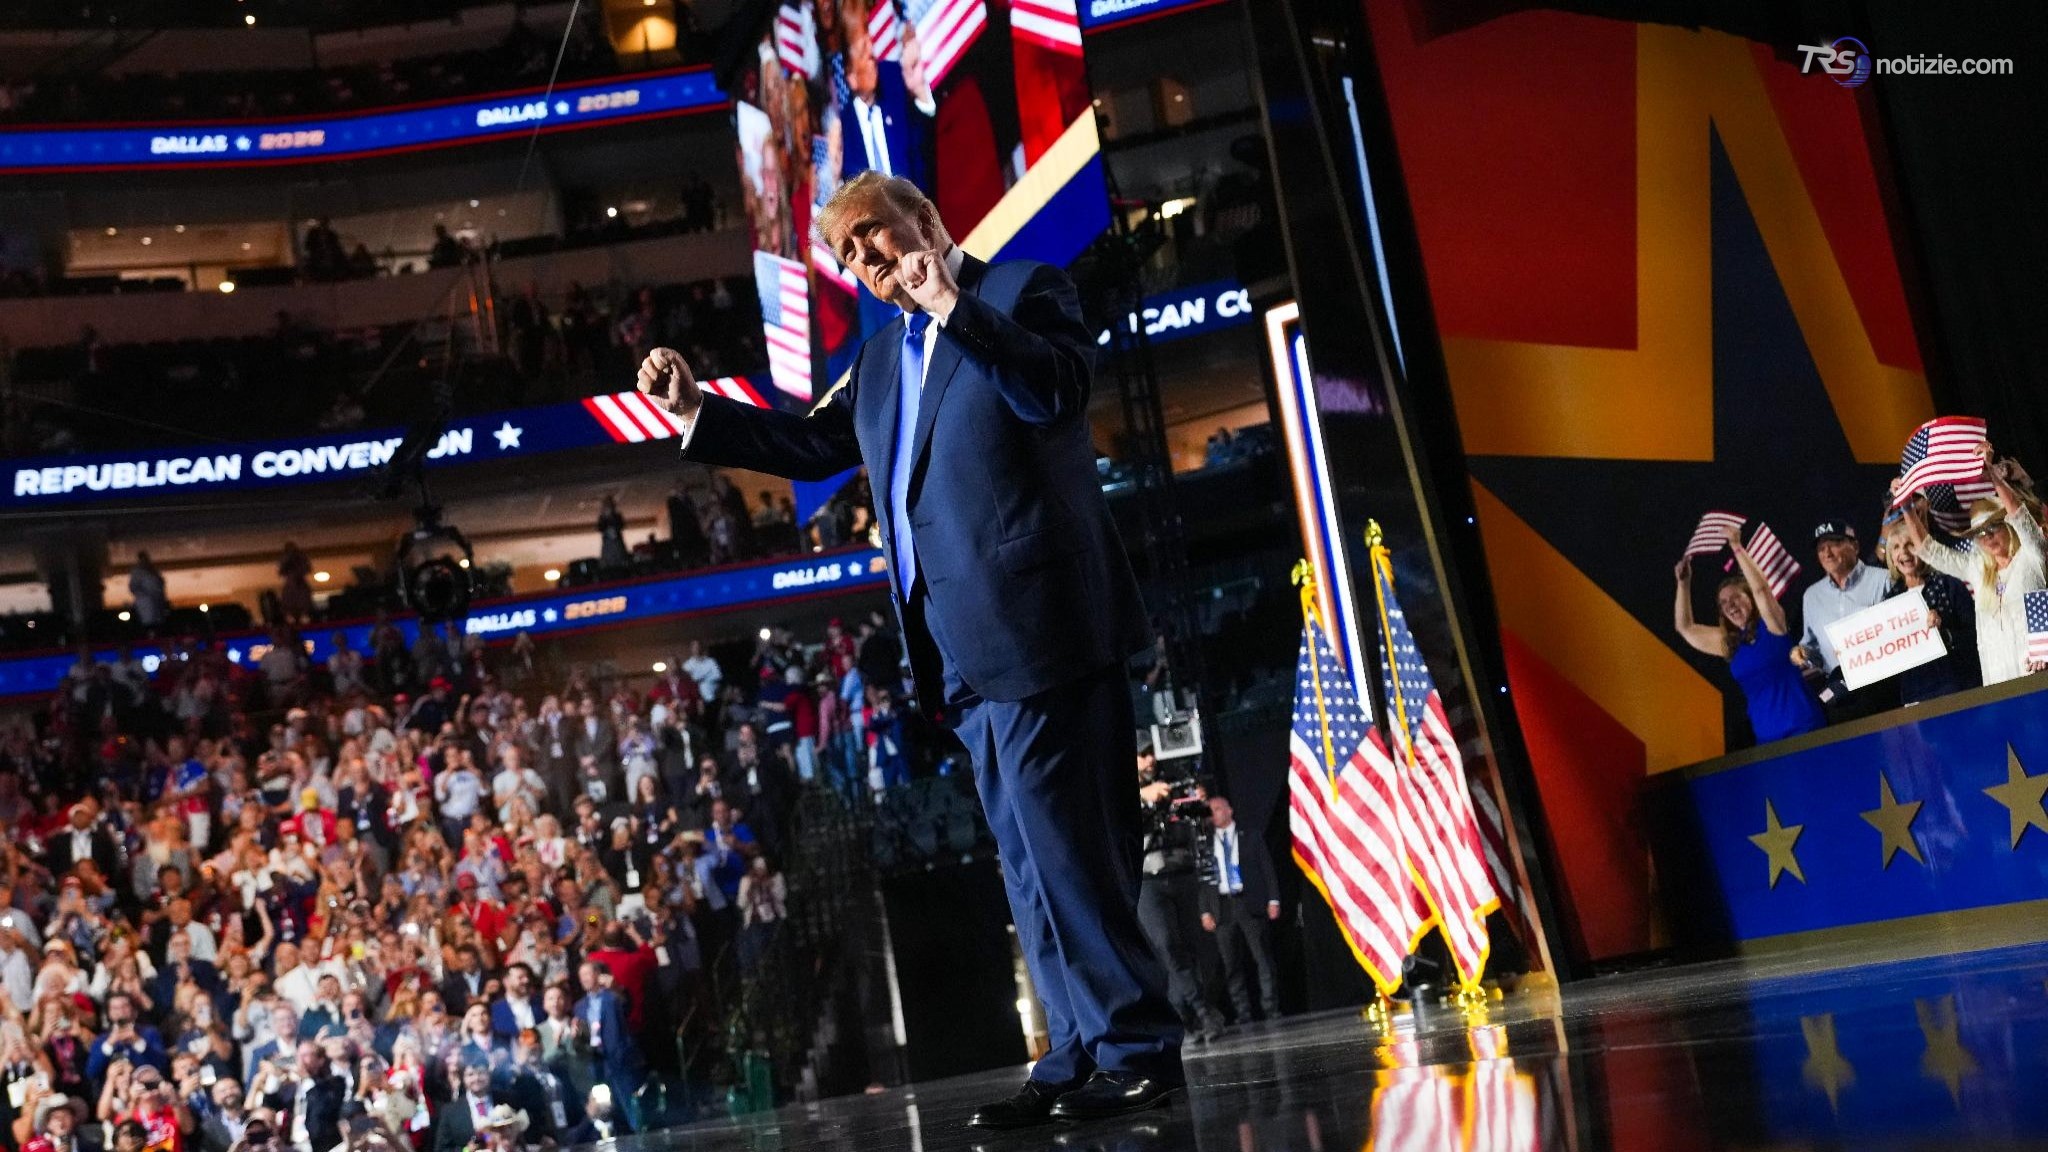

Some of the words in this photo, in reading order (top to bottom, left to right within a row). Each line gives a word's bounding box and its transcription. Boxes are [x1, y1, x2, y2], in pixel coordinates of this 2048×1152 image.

[476, 101, 548, 127] DALLAS
[150, 134, 229, 154] DALLAS
[14, 453, 243, 496] REPUBLICAN
[772, 563, 842, 590] DALLAS
[465, 609, 537, 634] DALLAS
[1843, 623, 1884, 649] KEEP
[1887, 608, 1920, 631] THE
[1848, 628, 1931, 670] MAJORITY
